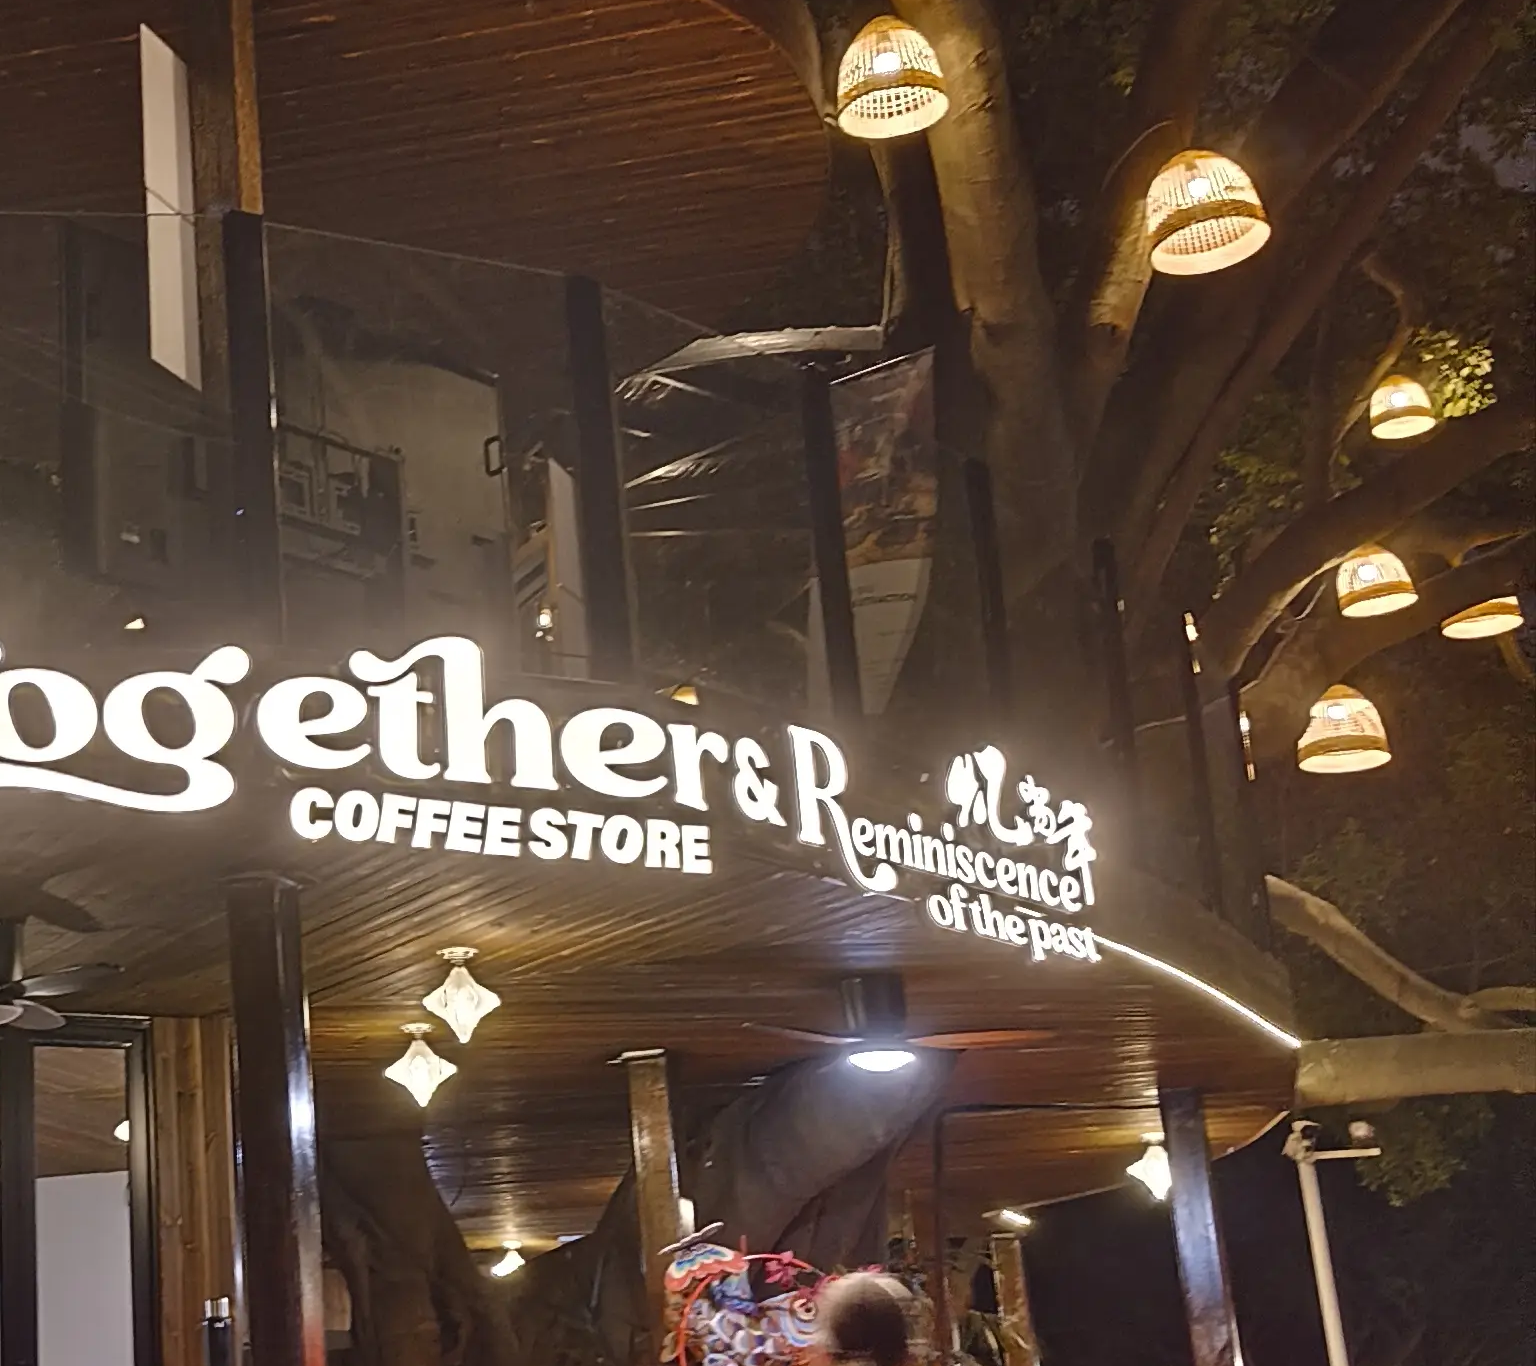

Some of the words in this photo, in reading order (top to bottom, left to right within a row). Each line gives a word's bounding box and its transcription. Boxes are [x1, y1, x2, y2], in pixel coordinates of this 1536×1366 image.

[289, 786, 523, 858] COFFEE
[527, 806, 714, 875] STORE
[733, 736, 788, 827] &
[788, 724, 1085, 912] Reminiscence
[927, 882, 971, 932] of
[967, 892, 1030, 947] the
[1027, 916, 1104, 965] past
